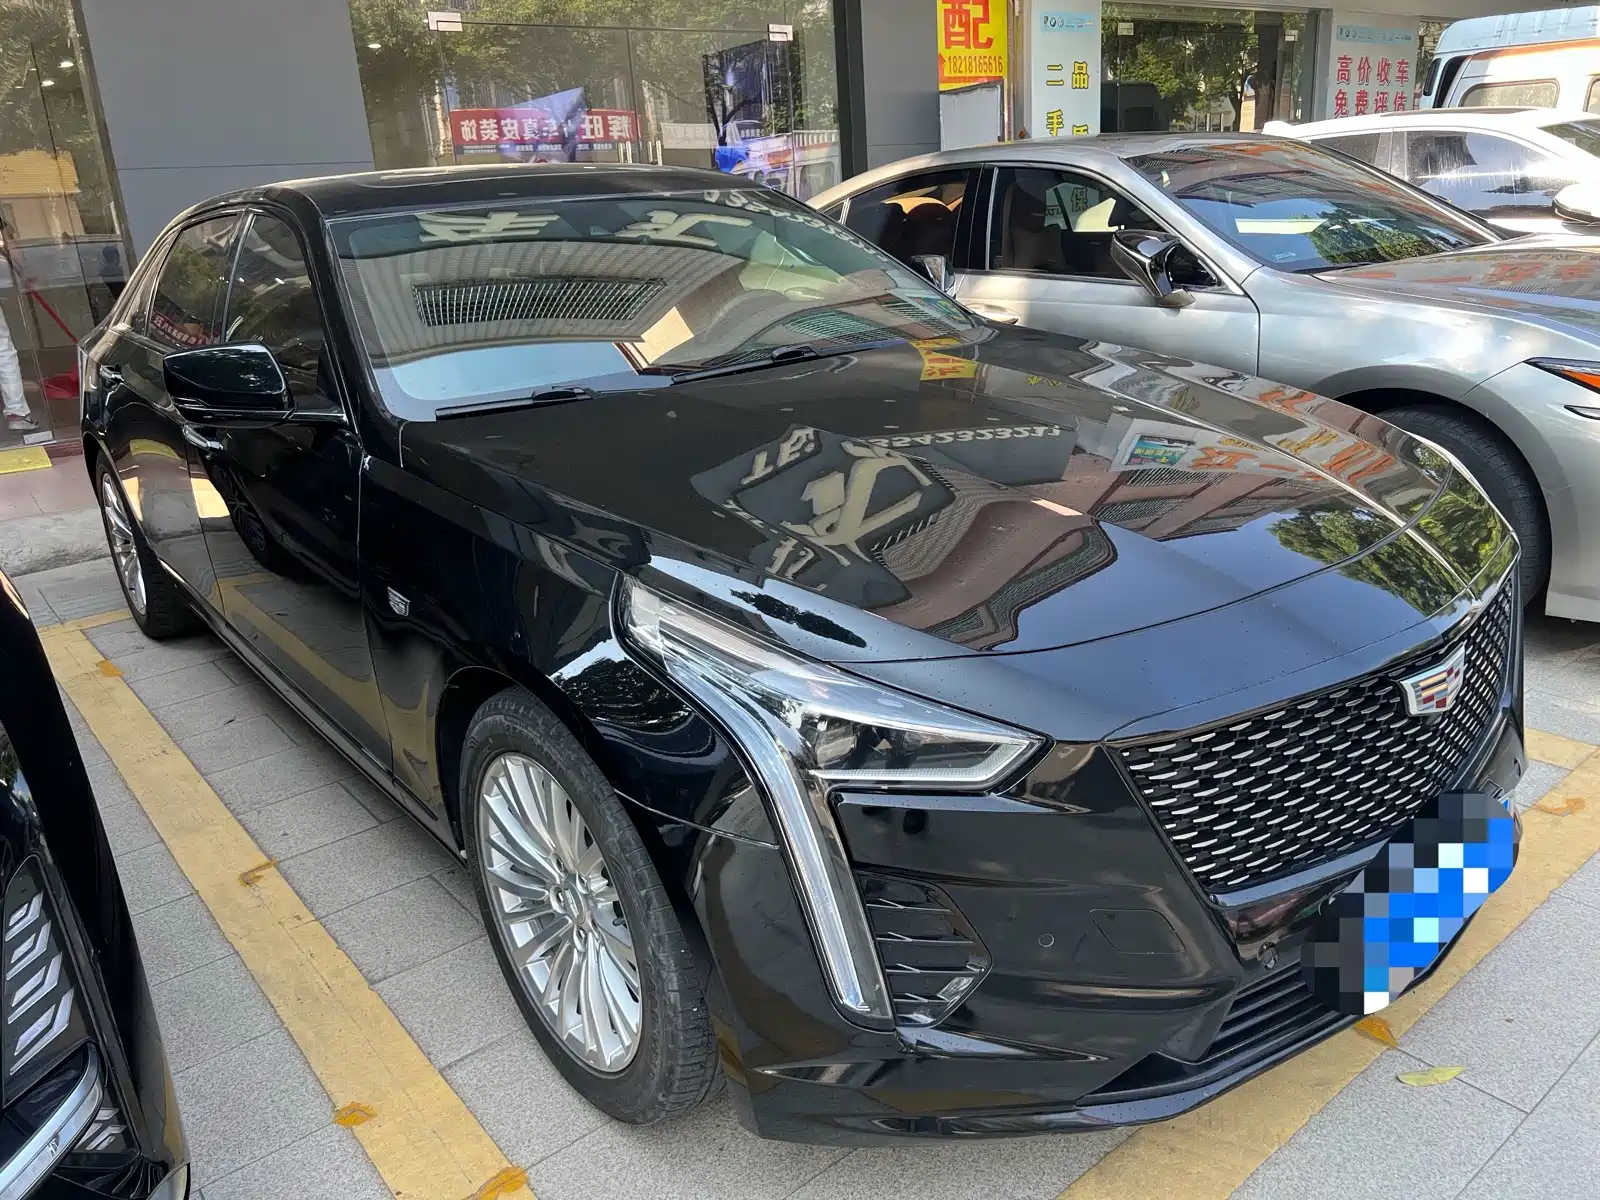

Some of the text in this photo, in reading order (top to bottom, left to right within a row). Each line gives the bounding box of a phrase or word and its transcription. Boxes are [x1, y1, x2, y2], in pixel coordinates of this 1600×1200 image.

[942, 0, 994, 49] 配
[948, 55, 1003, 74] 18218165616
[1336, 55, 1410, 86] 高价收车
[1334, 89, 1408, 118] 免费评估
